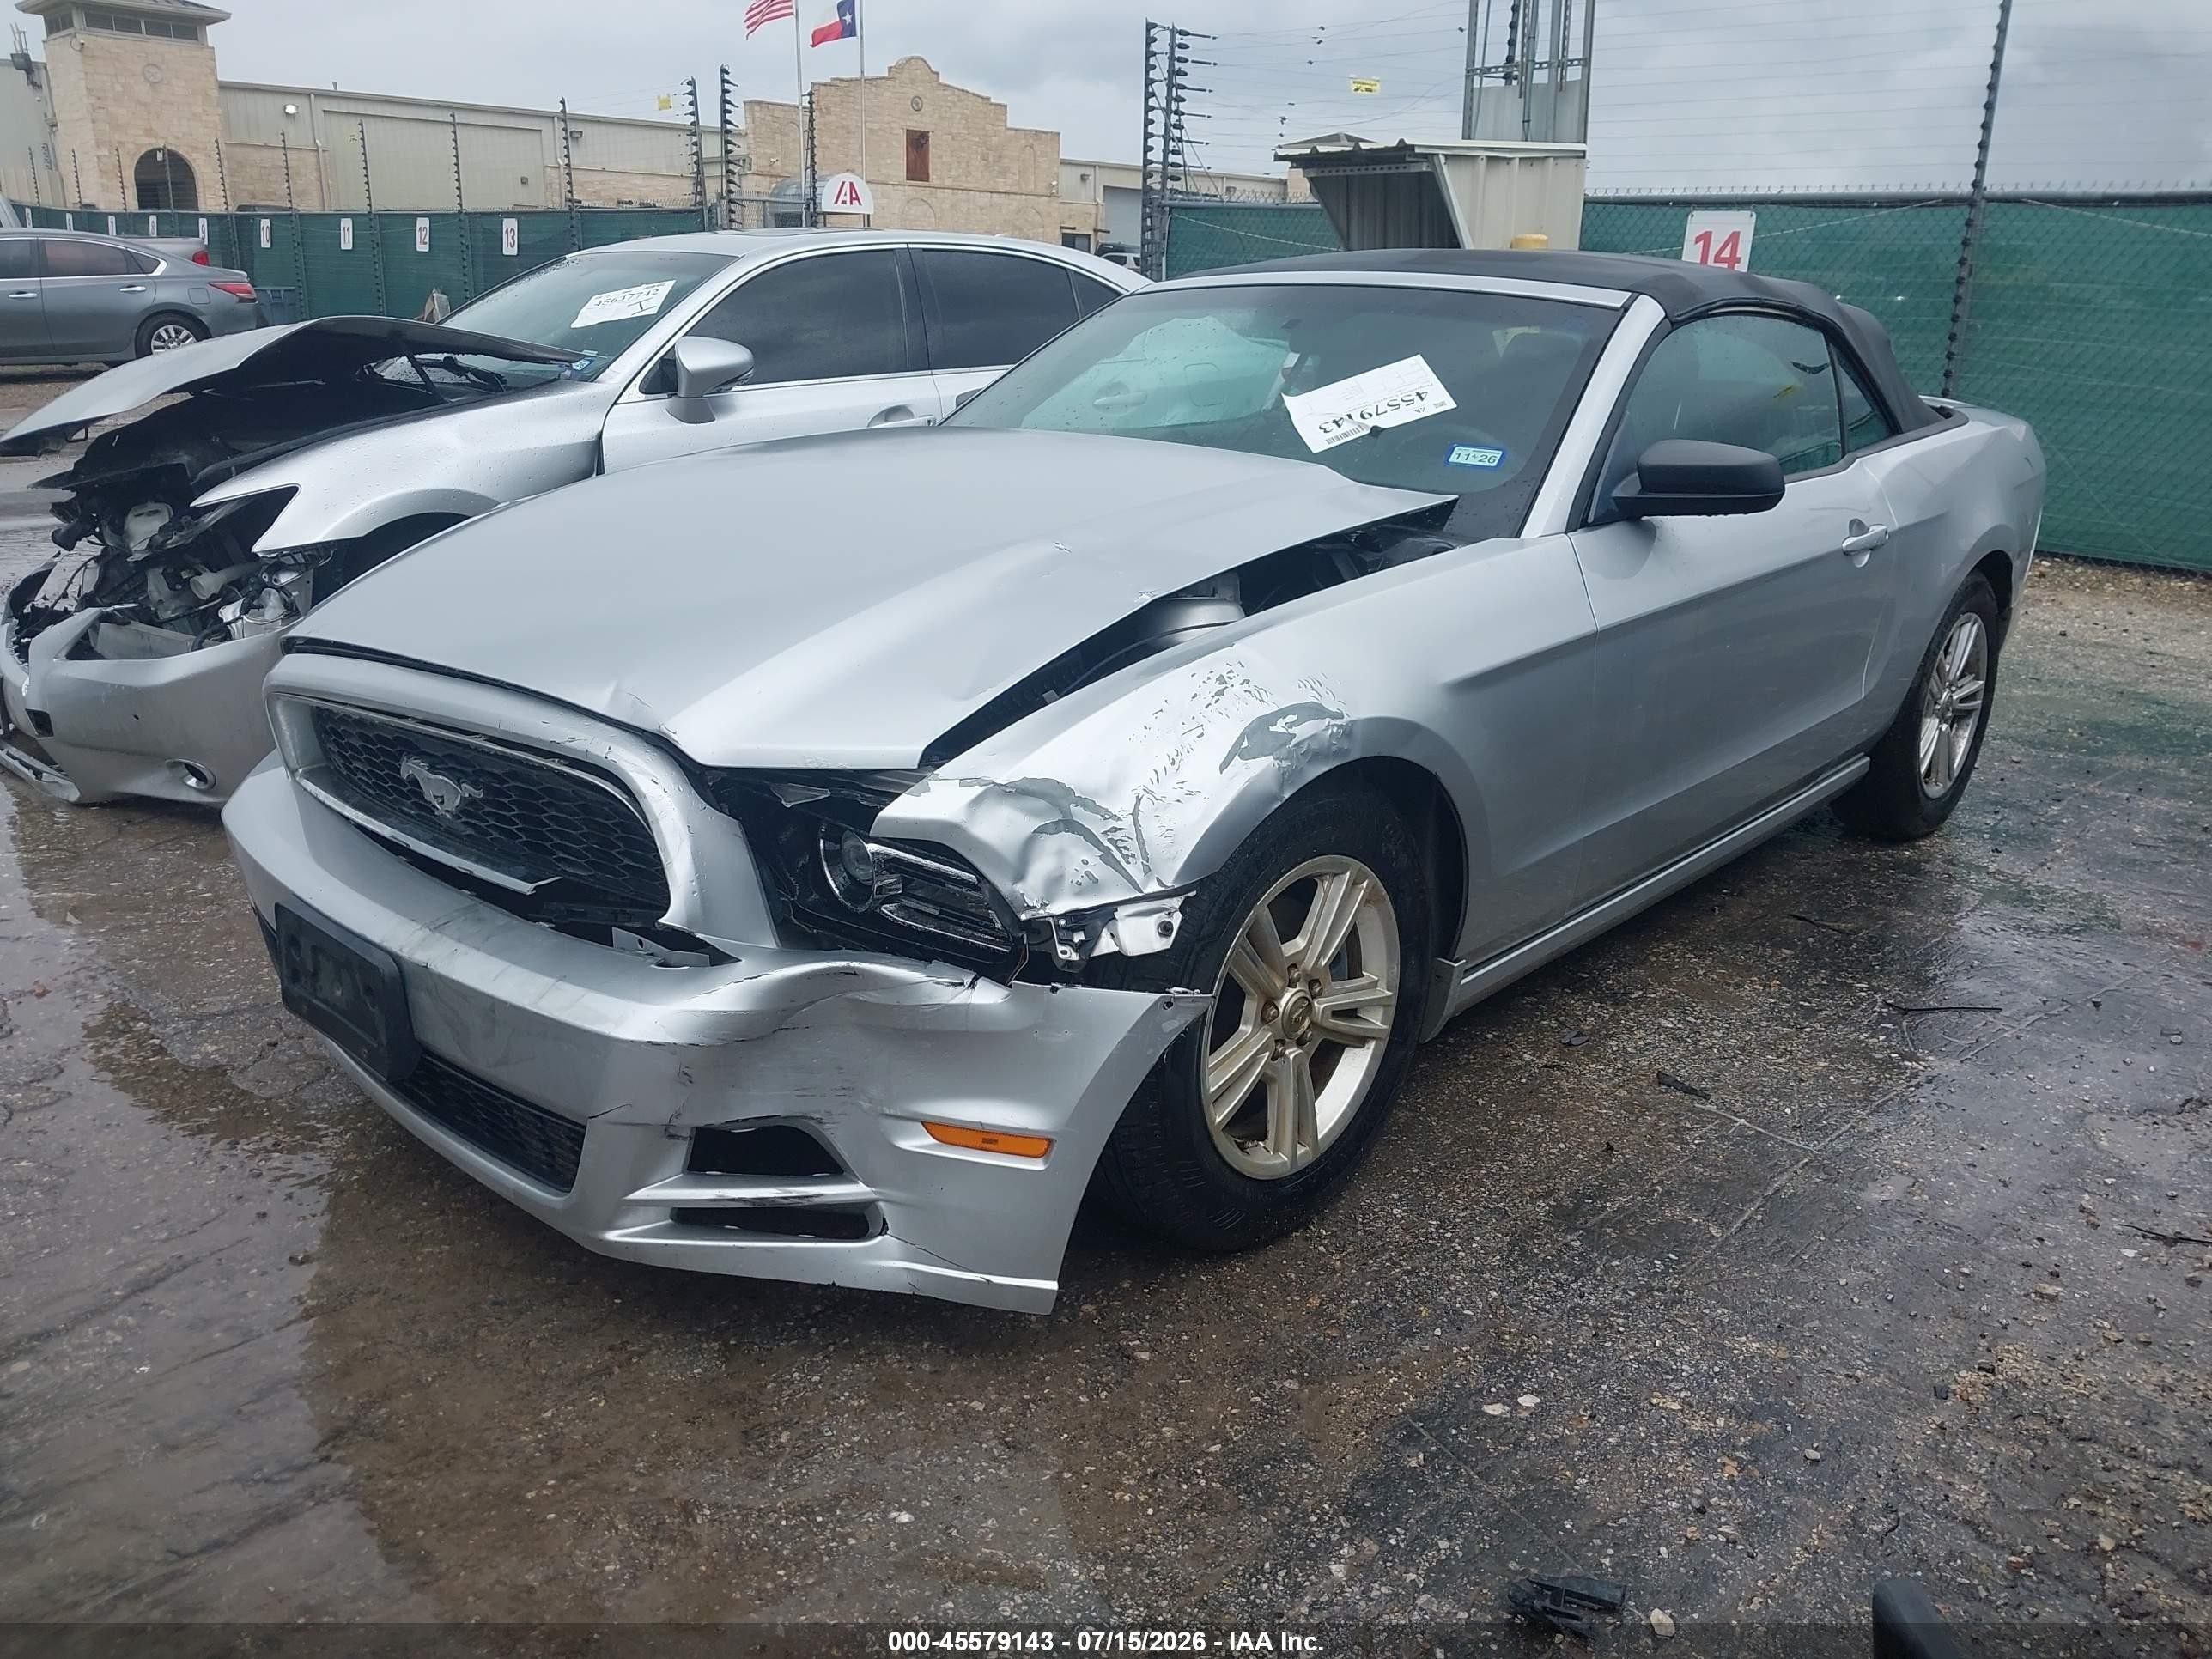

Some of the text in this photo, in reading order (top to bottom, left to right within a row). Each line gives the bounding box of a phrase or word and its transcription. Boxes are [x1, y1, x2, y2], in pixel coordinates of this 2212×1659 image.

[261, 225, 270, 244] 10
[342, 226, 350, 245] 11
[417, 226, 428, 246] 12
[504, 227, 516, 249] 13
[1694, 230, 1742, 270] 14
